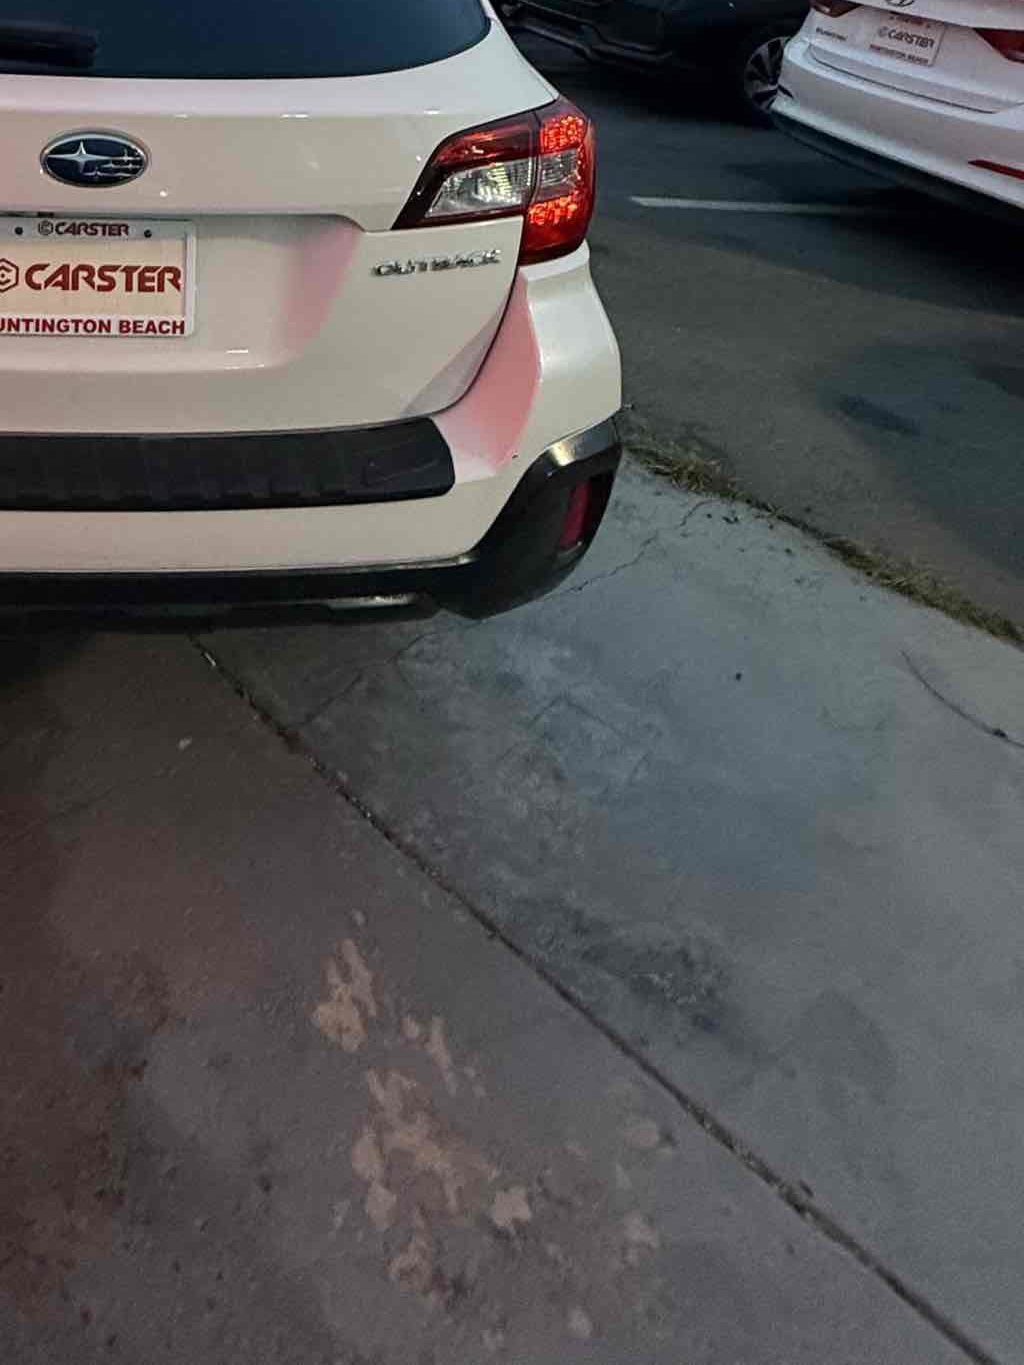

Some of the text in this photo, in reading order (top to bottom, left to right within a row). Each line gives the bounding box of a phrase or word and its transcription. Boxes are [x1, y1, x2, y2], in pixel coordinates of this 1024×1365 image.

[54, 221, 130, 237] CARSTER
[25, 263, 182, 293] CARSTER
[118, 319, 185, 335] BEACH
